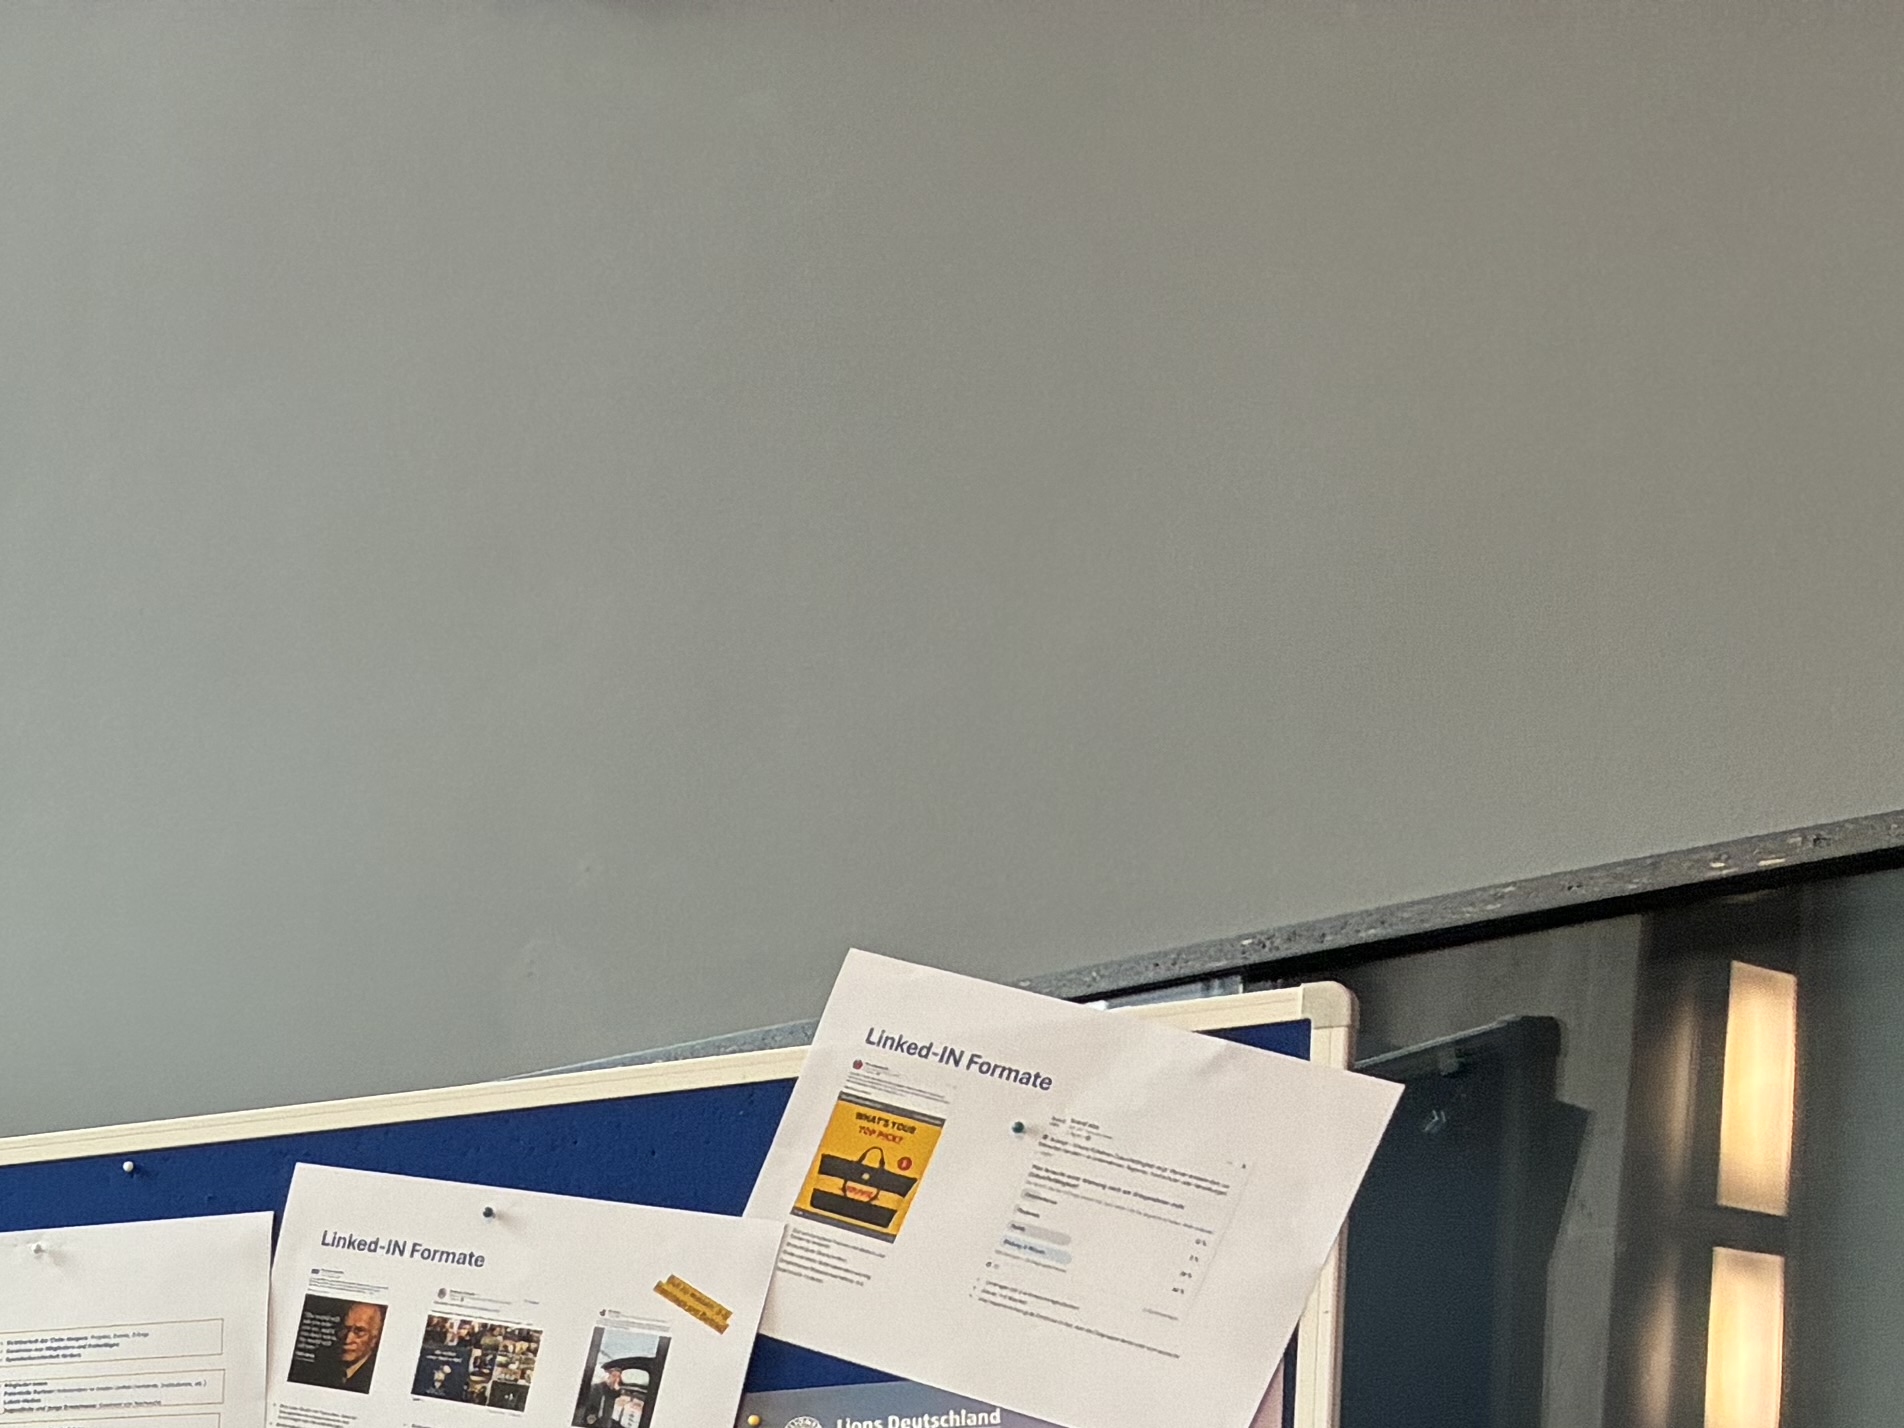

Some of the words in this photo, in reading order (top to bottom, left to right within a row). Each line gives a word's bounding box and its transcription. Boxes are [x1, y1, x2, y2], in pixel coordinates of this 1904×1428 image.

[864, 1027, 964, 1069] Linked-IN
[965, 1054, 1053, 1091] Formate
[321, 1229, 407, 1258] Linked-IN
[410, 1242, 486, 1268] Formate
